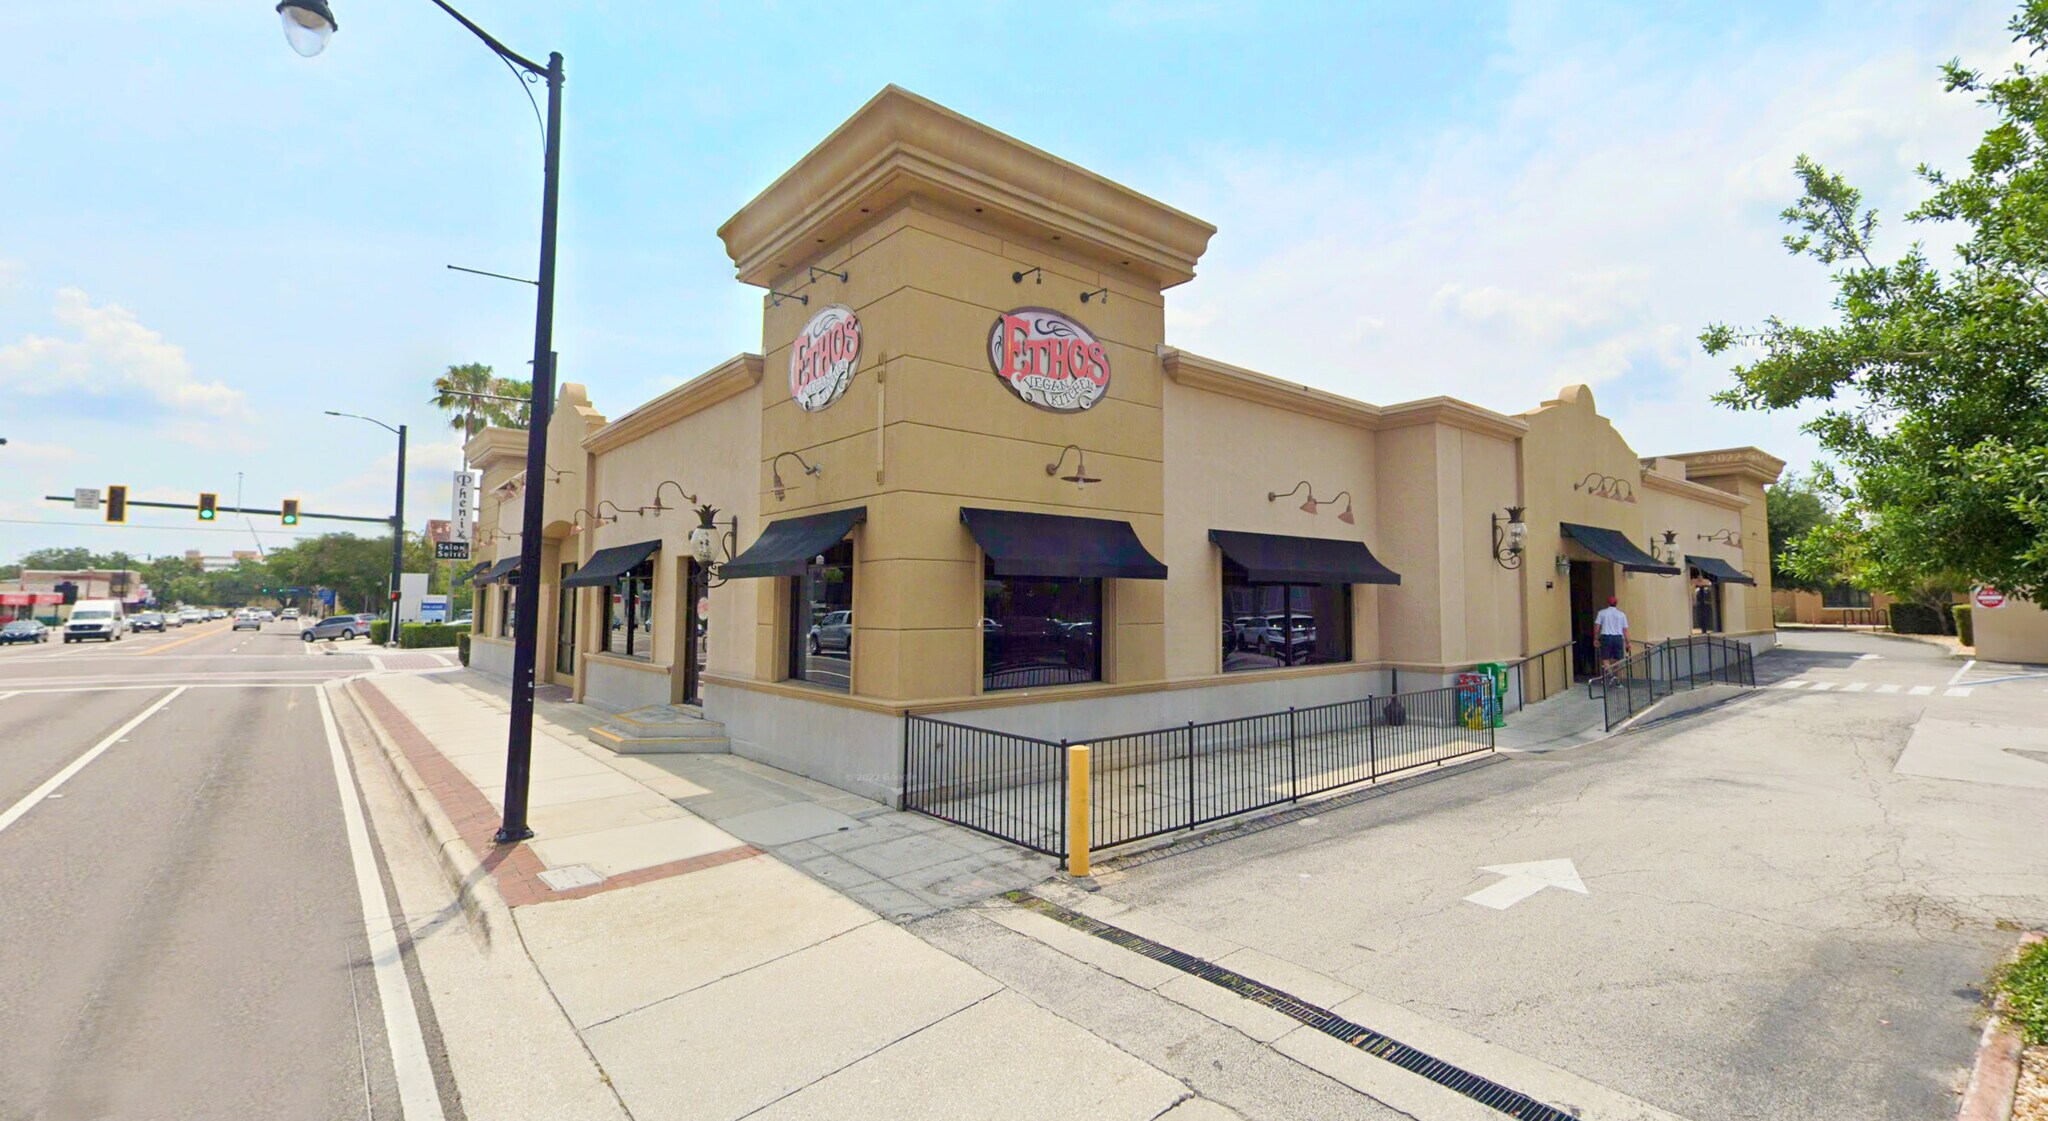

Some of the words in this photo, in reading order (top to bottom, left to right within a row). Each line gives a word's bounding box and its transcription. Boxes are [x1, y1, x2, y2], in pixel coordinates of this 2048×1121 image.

[792, 314, 858, 397] ETHOS
[999, 314, 1109, 387] ETHOS
[1024, 377, 1069, 391] VEGAN
[1051, 377, 1093, 406] KITCHEN
[456, 474, 472, 540] Phenix
